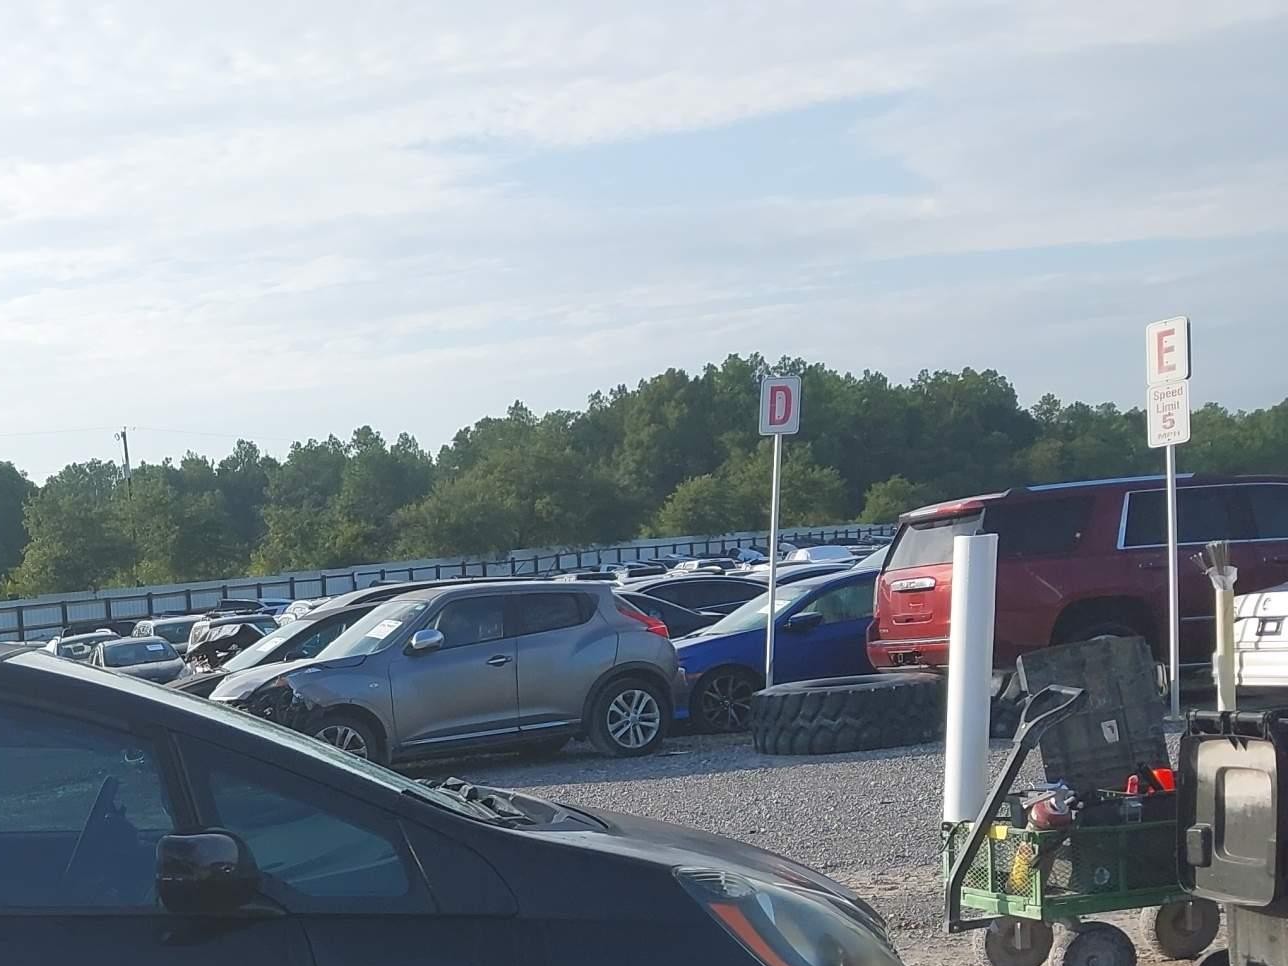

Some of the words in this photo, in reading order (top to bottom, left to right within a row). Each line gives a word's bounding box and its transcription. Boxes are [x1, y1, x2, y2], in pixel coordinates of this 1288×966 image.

[1157, 328, 1176, 374] E
[1153, 386, 1184, 402] Speed
[769, 386, 792, 426] D
[1156, 401, 1180, 414] Limit
[1162, 413, 1175, 429] 5
